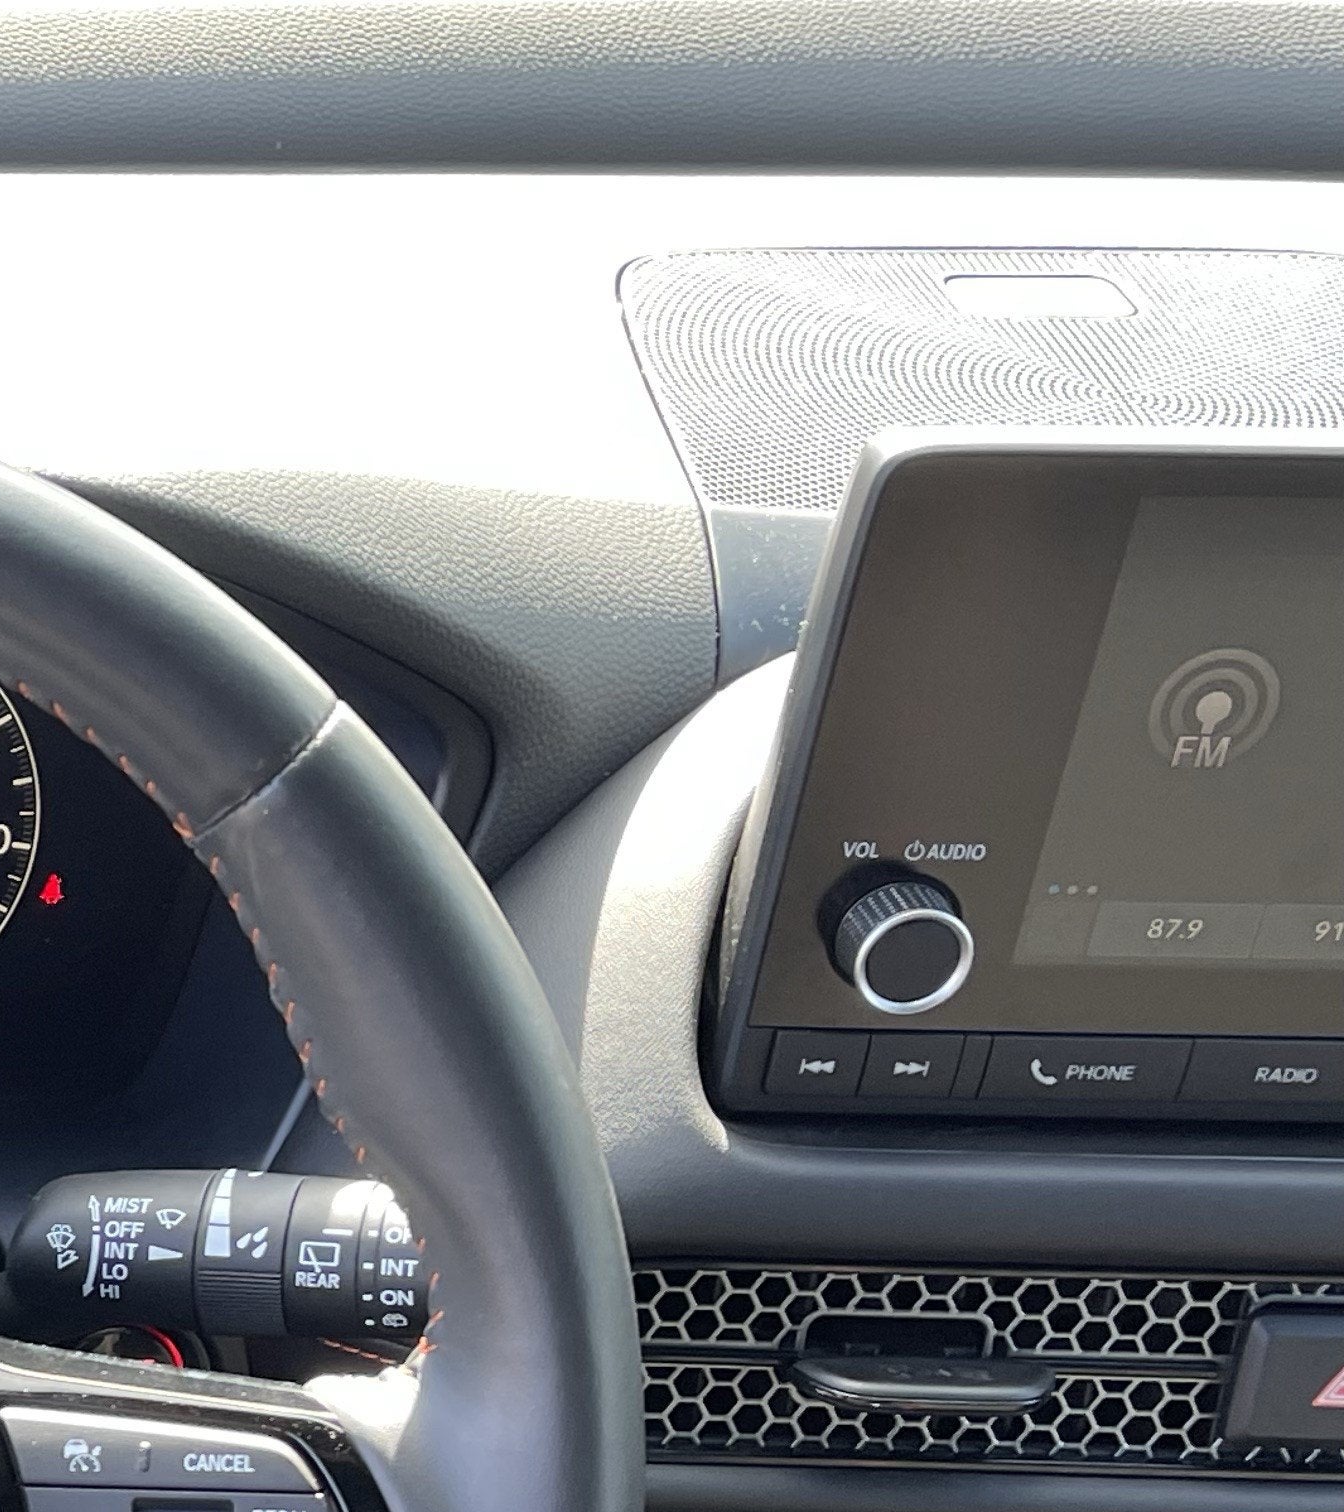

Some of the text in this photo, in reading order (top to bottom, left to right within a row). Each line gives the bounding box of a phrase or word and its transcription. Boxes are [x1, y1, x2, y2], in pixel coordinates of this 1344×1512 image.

[1169, 734, 1233, 770] FM
[842, 840, 880, 861] VOL
[926, 841, 988, 862] AUDIO
[1146, 917, 1204, 941] 87.9
[1064, 1062, 1136, 1084] PHONE
[1253, 1066, 1319, 1085] RADIO
[104, 1196, 153, 1215] MIST
[103, 1220, 144, 1239] OFF
[103, 1241, 139, 1261] INT
[101, 1263, 129, 1282] LO
[379, 1257, 420, 1278] INT
[294, 1270, 341, 1290] REAR
[99, 1283, 122, 1300] HI
[379, 1289, 415, 1307] ON
[182, 1452, 256, 1474] CANCEL
